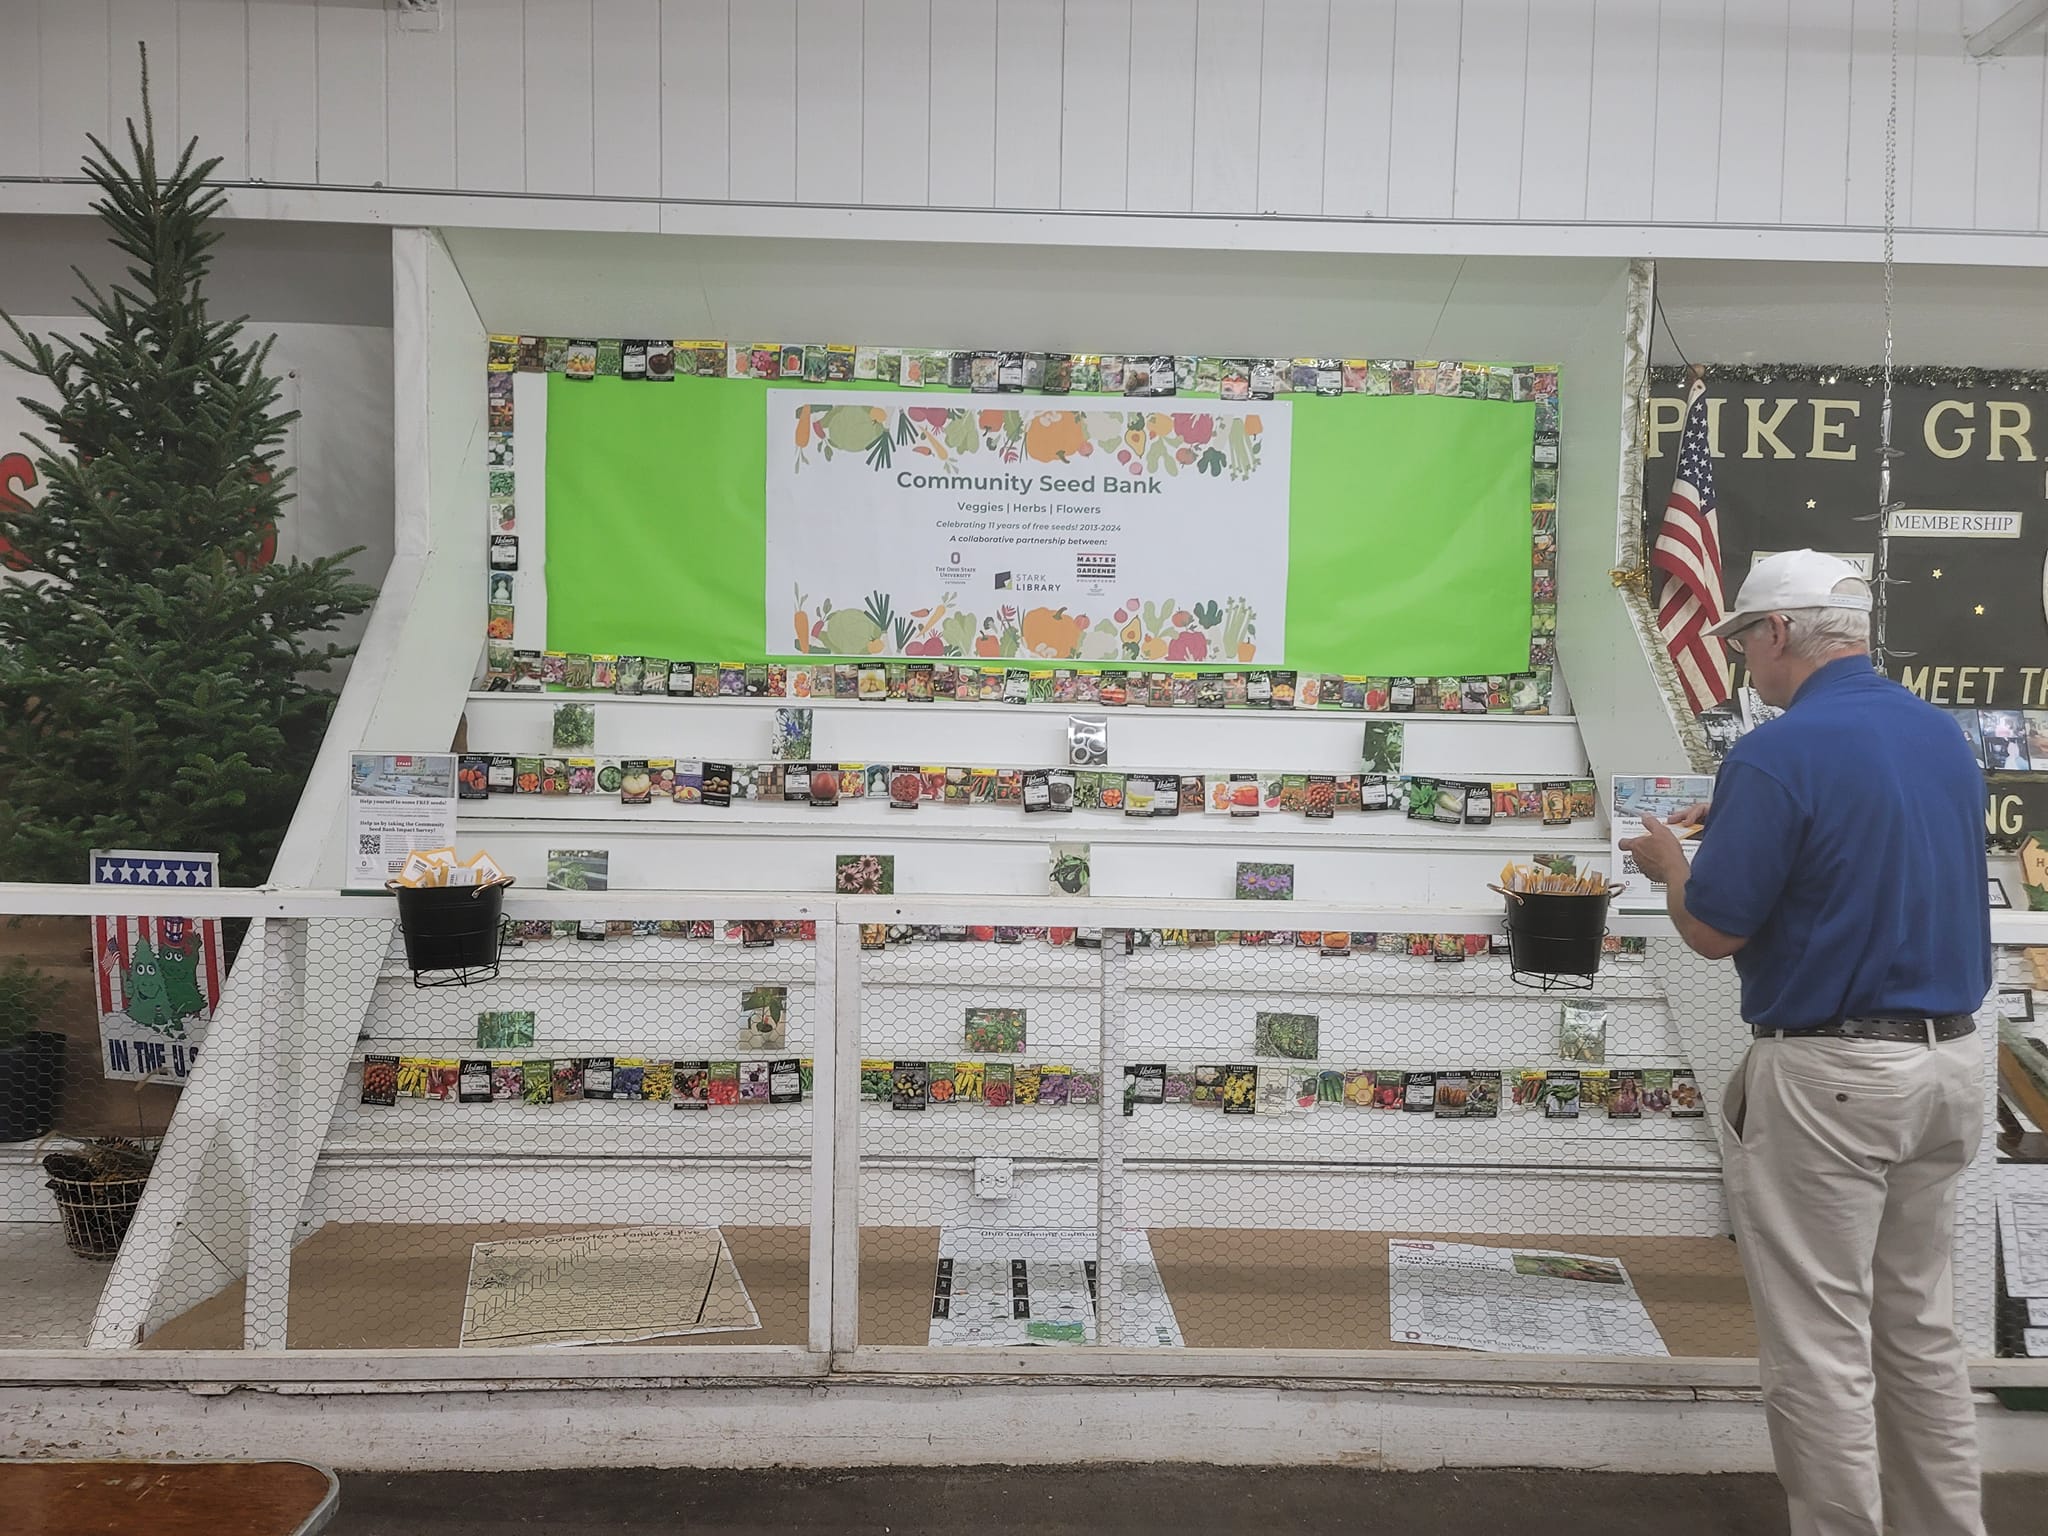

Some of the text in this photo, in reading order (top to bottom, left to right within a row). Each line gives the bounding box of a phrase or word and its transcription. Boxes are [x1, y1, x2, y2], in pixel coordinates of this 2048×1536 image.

[1648, 397, 2048, 462] PIKE GR
[897, 471, 1162, 495] Community Seed Bank
[957, 502, 1101, 514] Veggies Herbs Flowers
[936, 520, 987, 530] Celebrating
[996, 522, 1020, 530] years
[1021, 522, 1031, 530] of
[1032, 522, 1049, 530] free
[1051, 523, 1078, 531] seeds!
[1079, 524, 1121, 532] 2013-2024
[1894, 514, 2013, 531] MEMBERSHIP
[958, 535, 1014, 544] collaborative
[1015, 536, 1066, 546] partnership
[1067, 537, 1108, 546] between:
[1015, 574, 1046, 582] STARK
[1016, 583, 1061, 592] LIBRARY
[1902, 665, 2004, 705] MEET
[108, 1038, 130, 1073] IN
[134, 1041, 168, 1075] THE
[506, 1237, 541, 1246] ictory
